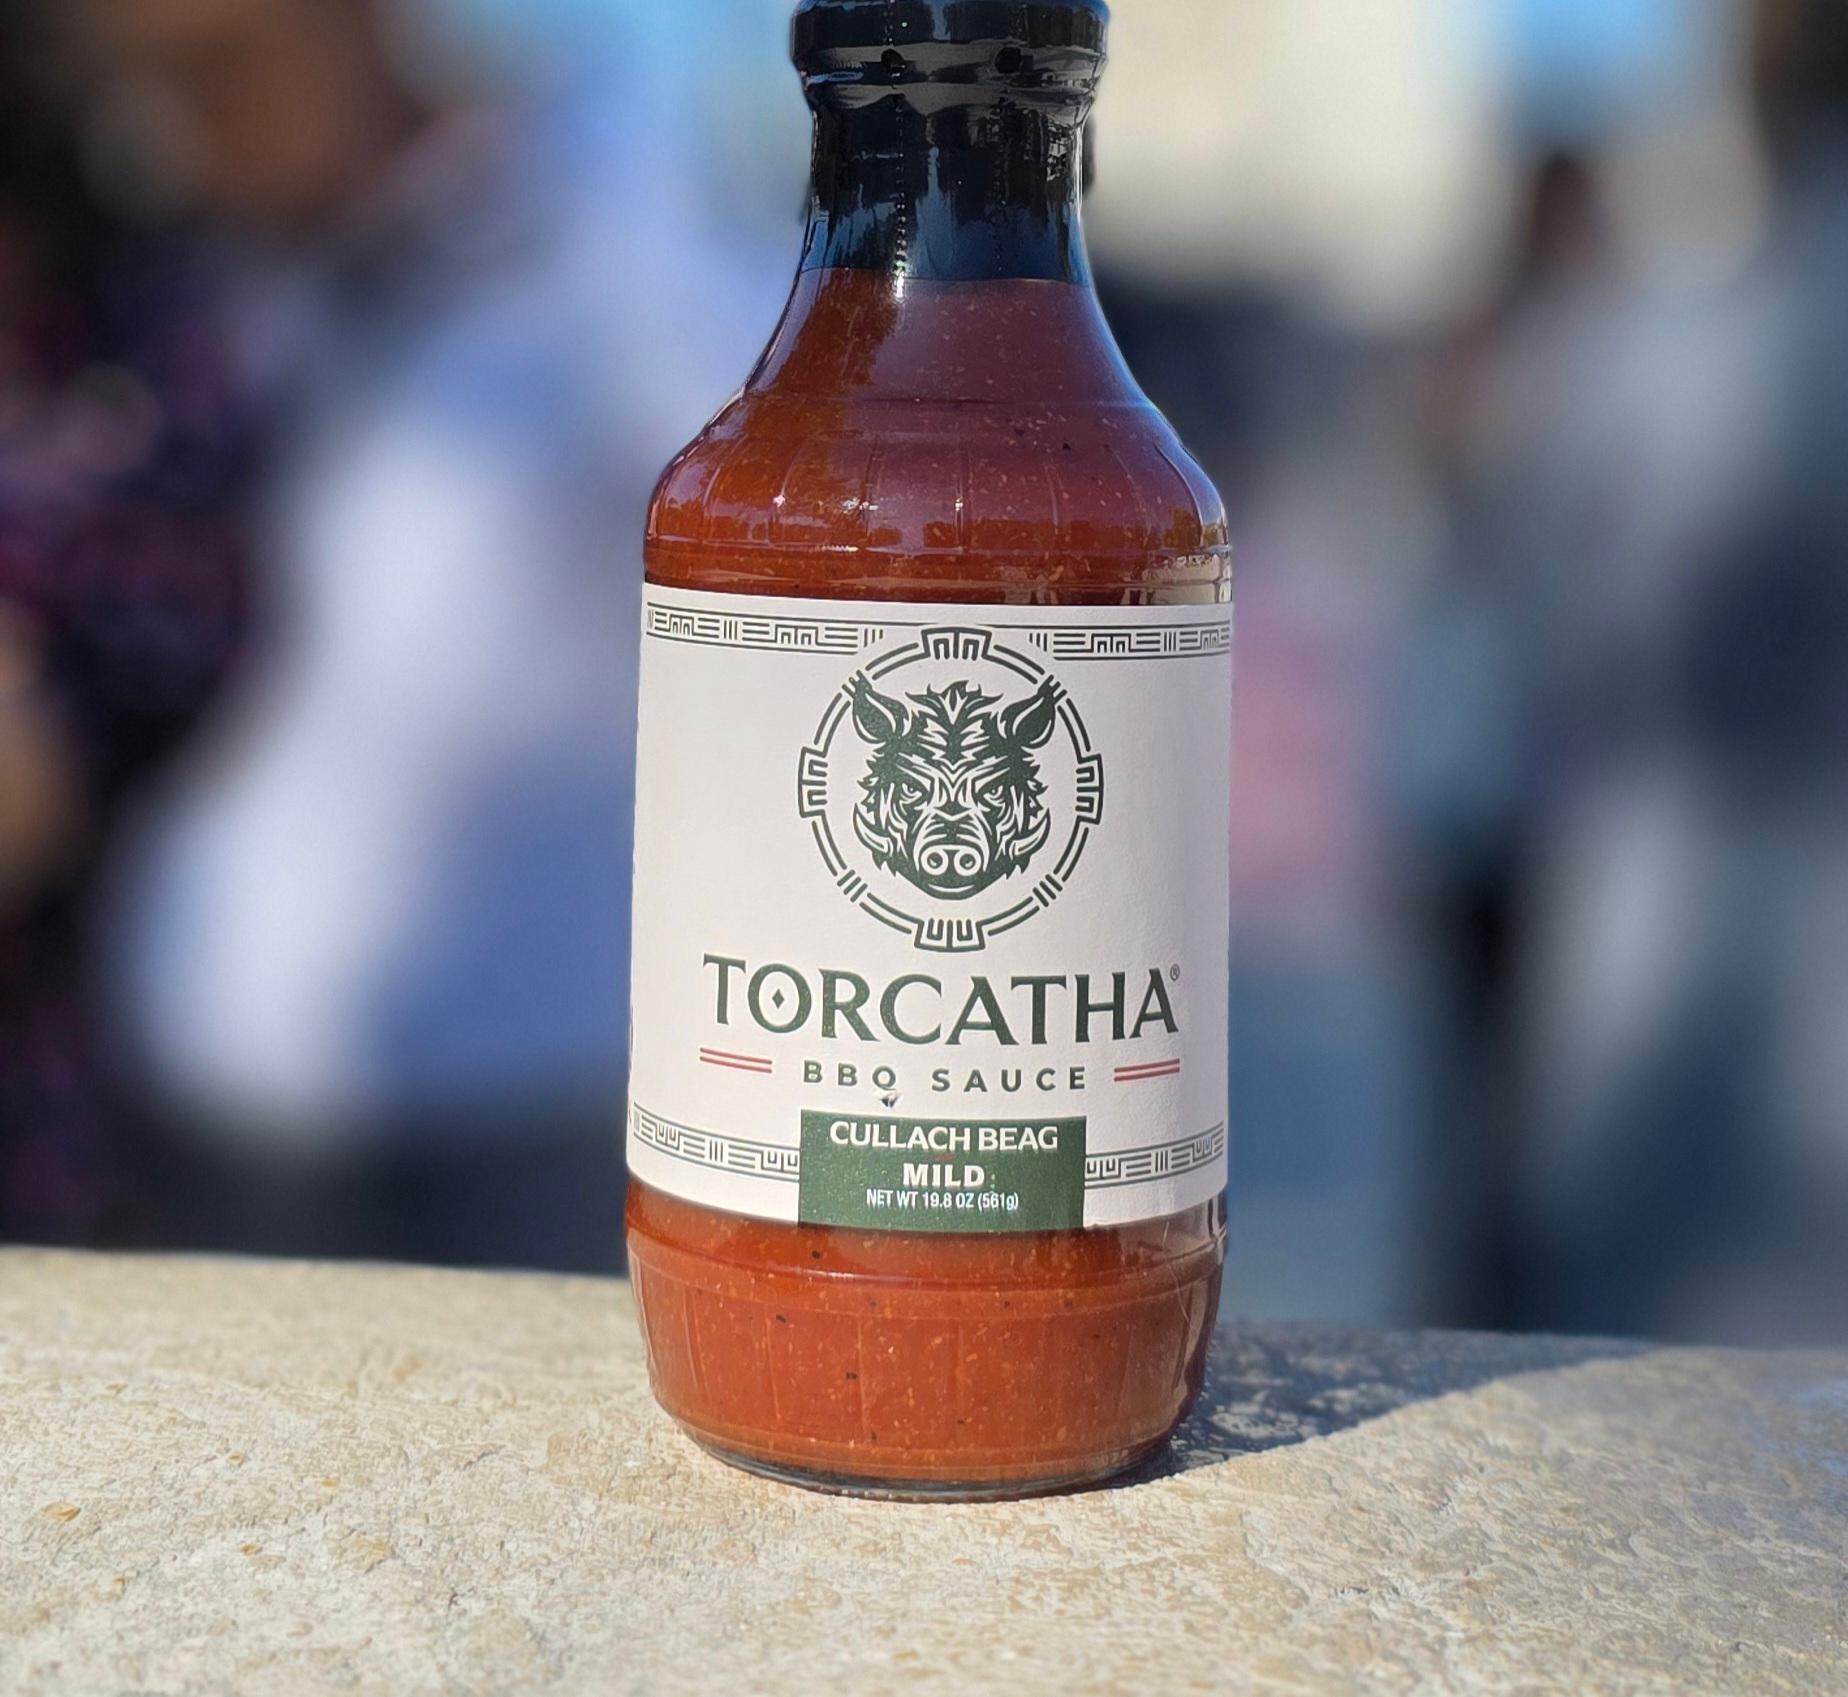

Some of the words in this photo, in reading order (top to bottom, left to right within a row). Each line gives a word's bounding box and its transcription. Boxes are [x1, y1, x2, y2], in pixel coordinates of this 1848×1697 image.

[803, 1060, 897, 1091] BBQ
[932, 1066, 1085, 1093] SAUCE
[829, 1121, 970, 1151] CULLACH
[978, 1126, 1058, 1151] BEAG
[902, 1163, 985, 1188] MILD
[866, 1188, 893, 1207] NET
[897, 1190, 918, 1208] WT
[922, 1192, 951, 1209] 19.8
[955, 1192, 974, 1209] OZ
[977, 1191, 1019, 1212] (561g)
